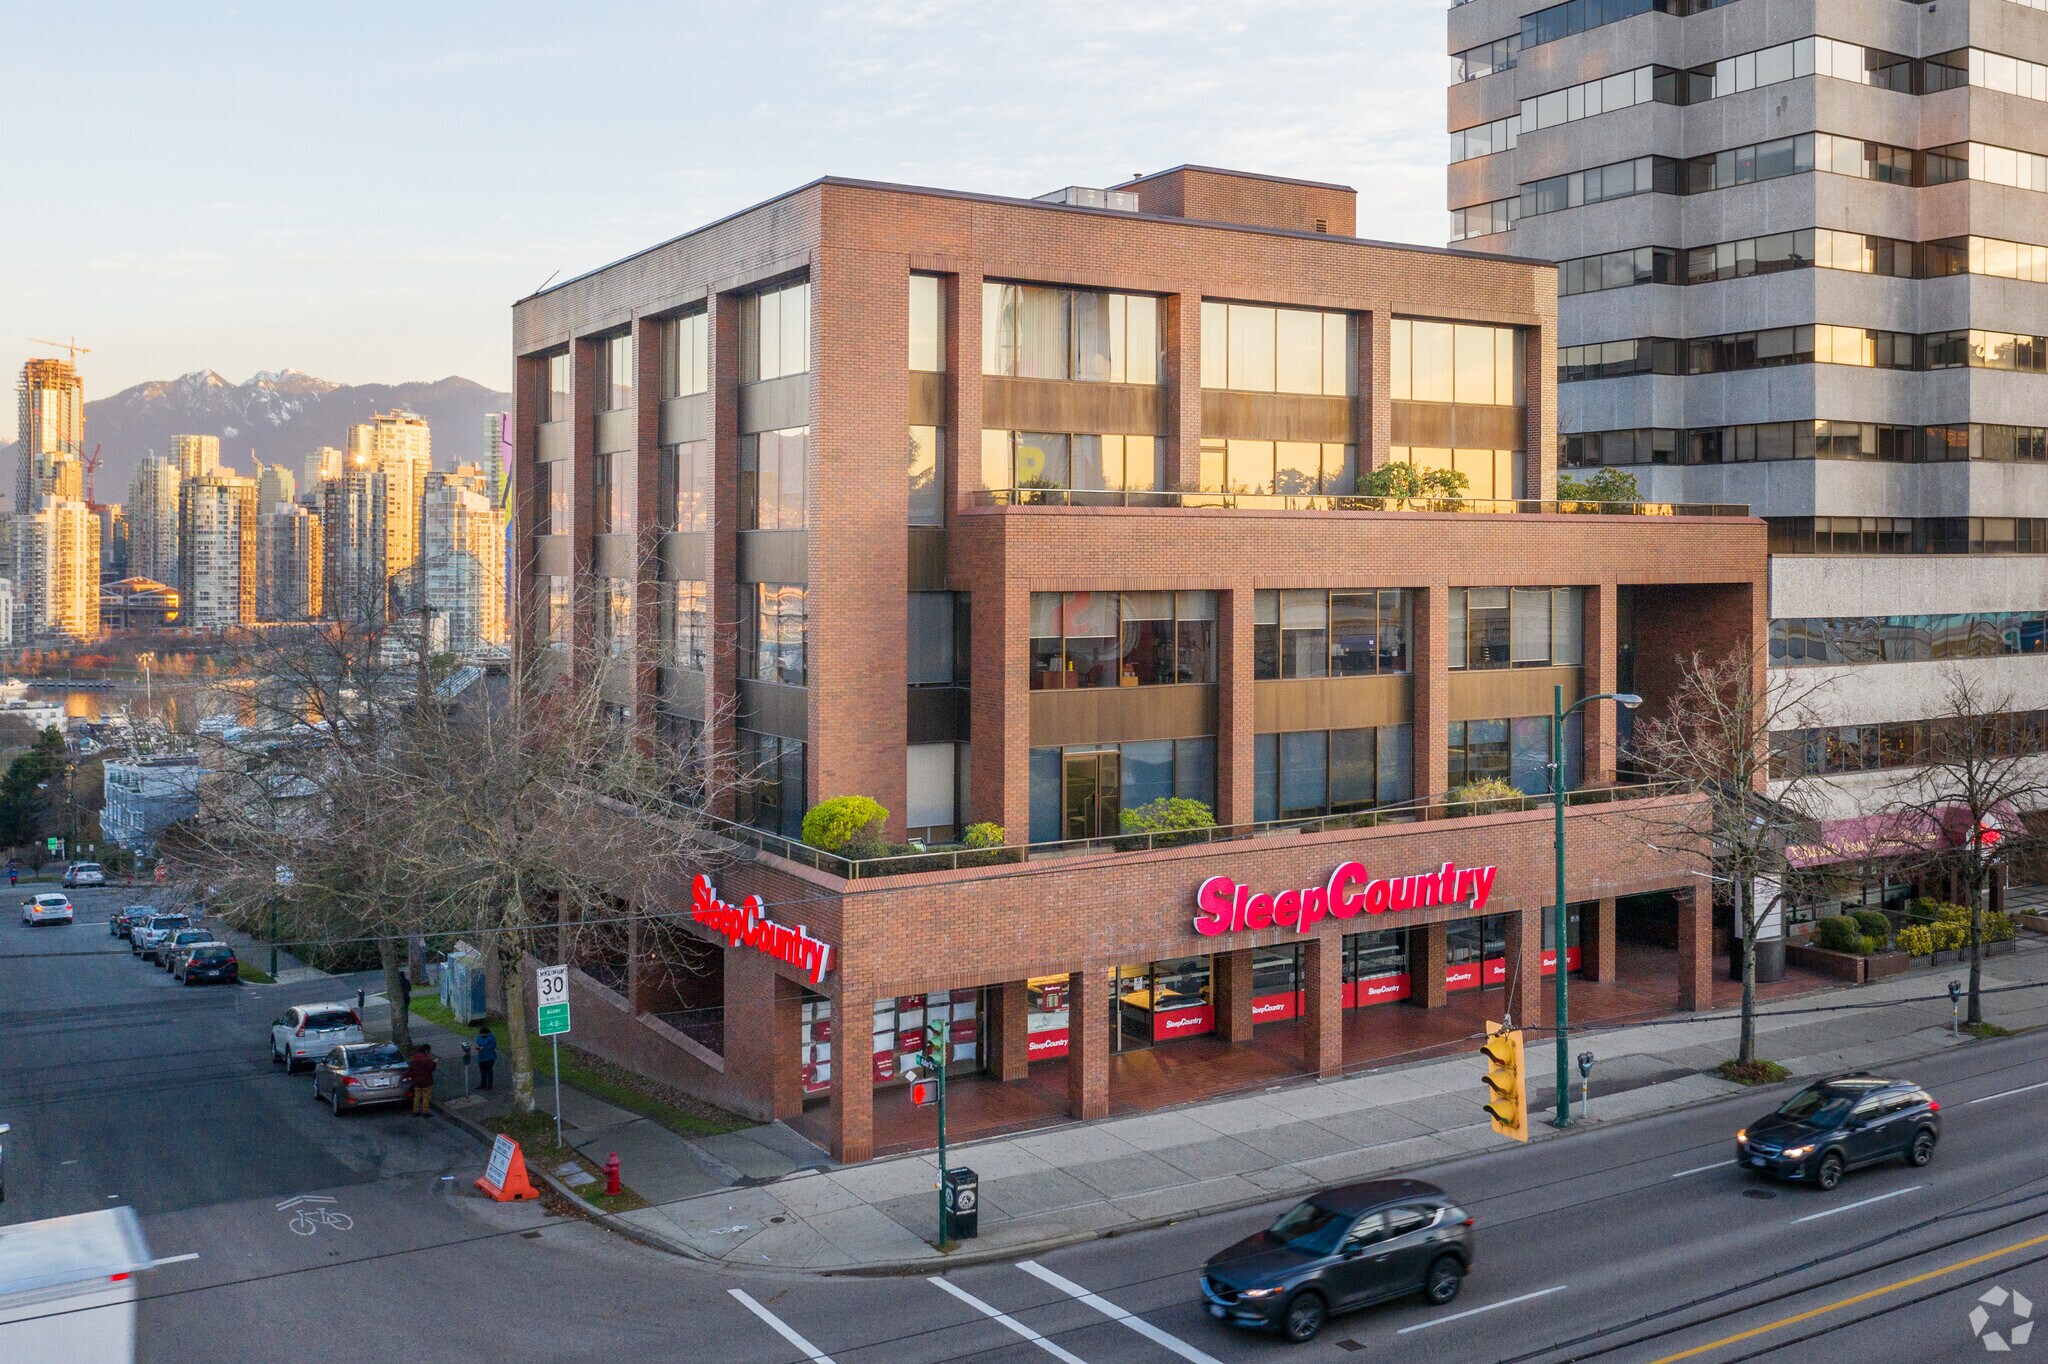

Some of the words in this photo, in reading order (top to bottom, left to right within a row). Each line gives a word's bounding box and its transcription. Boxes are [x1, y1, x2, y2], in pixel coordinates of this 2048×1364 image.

[1193, 861, 1497, 936] SleepCountry
[692, 873, 830, 985] SleepCountry
[542, 976, 563, 995] 30
[1368, 985, 1400, 996] SleepCountry
[1166, 1016, 1203, 1029] SleepCountry
[1028, 1039, 1069, 1051] SleepCountry
